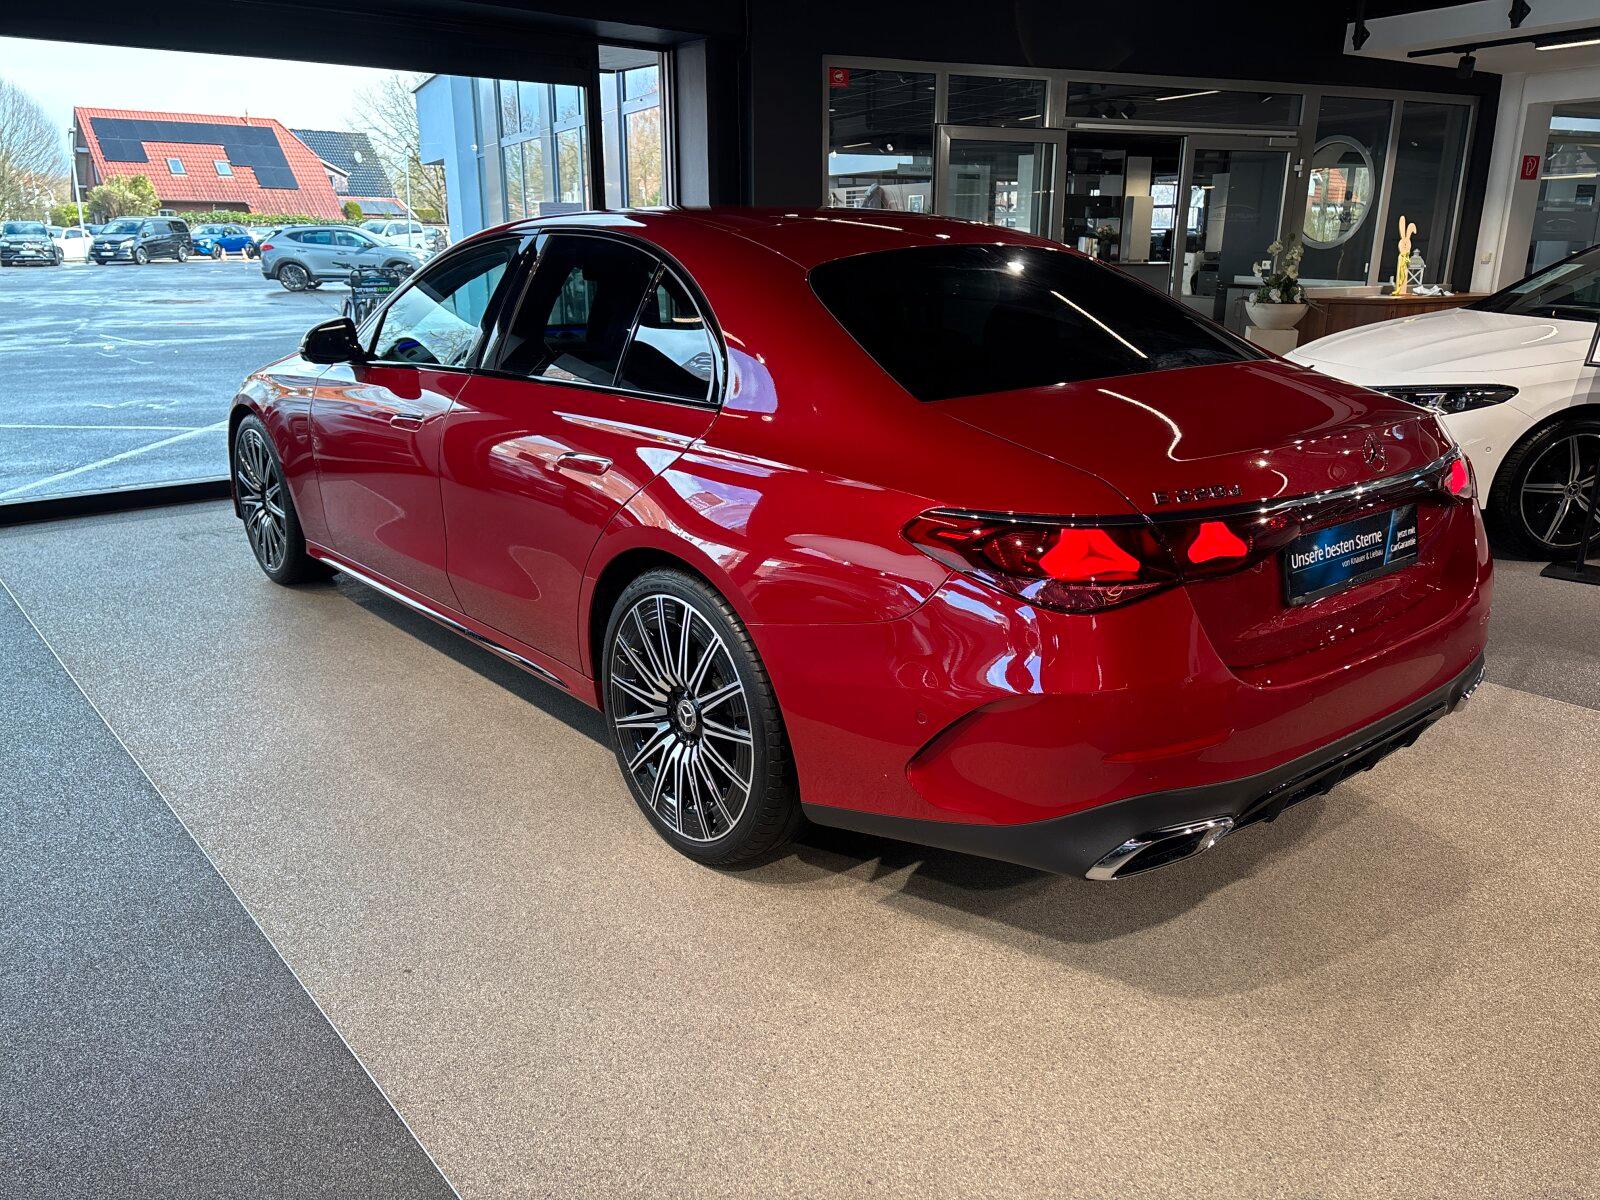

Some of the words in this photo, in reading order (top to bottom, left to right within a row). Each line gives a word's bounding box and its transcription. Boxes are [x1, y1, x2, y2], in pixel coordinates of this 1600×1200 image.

[1407, 526, 1416, 536] mit
[1291, 548, 1324, 569] Unsere
[1324, 539, 1355, 559] besten
[1355, 530, 1383, 549] Sterne
[1390, 537, 1416, 552] CarGarantie
[1341, 559, 1351, 568] von
[1350, 554, 1367, 565] Knauer
[1369, 548, 1384, 559] Liebau
